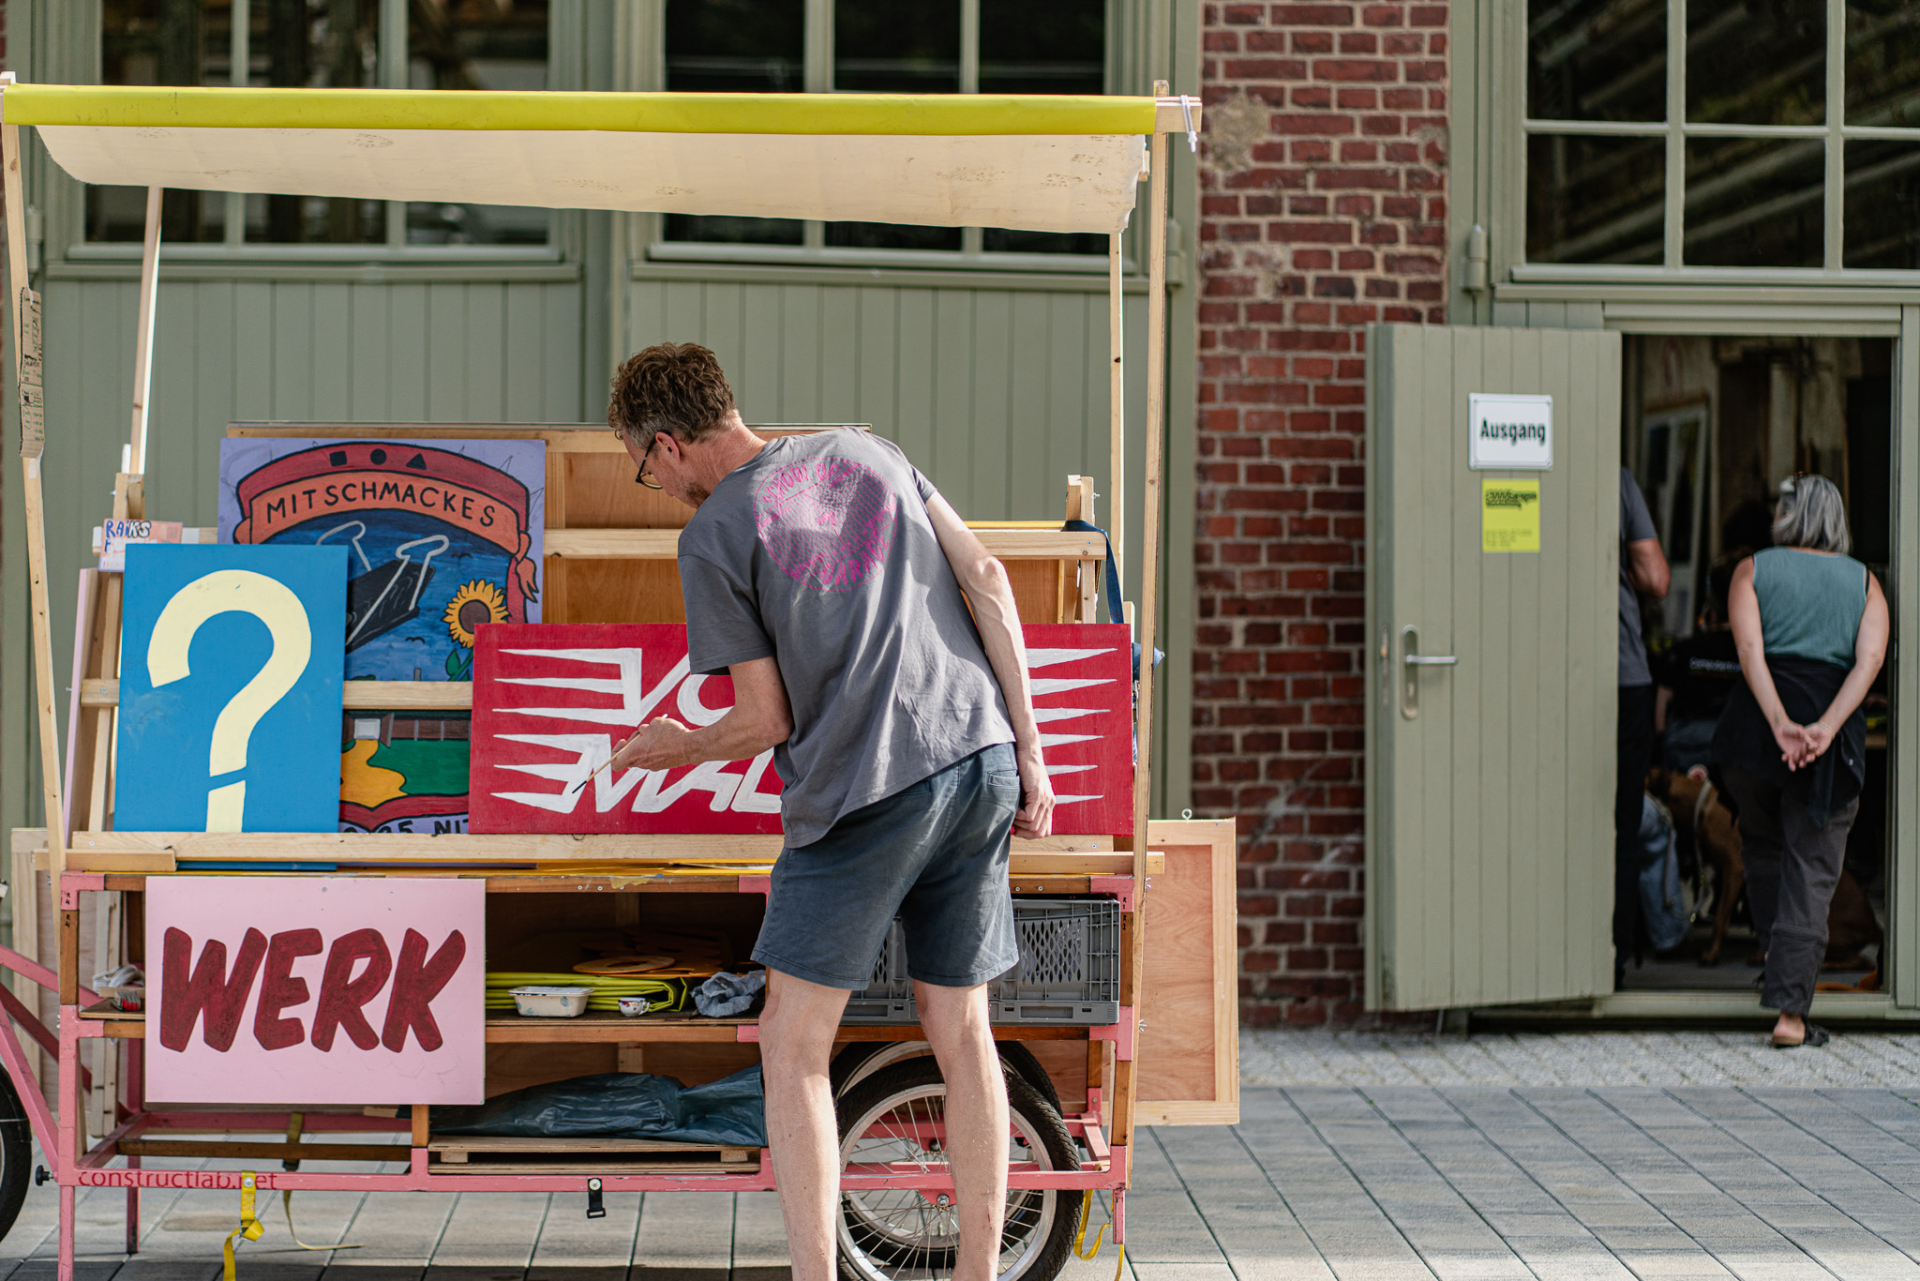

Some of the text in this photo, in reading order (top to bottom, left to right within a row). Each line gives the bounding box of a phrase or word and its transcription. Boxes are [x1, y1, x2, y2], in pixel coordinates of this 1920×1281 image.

[1480, 418, 1545, 447] Ausgang
[266, 481, 496, 527] MITSCHMACKES
[761, 464, 812, 508] SCHOOL
[820, 528, 889, 586] GARAGE
[160, 926, 467, 1053] WERK
